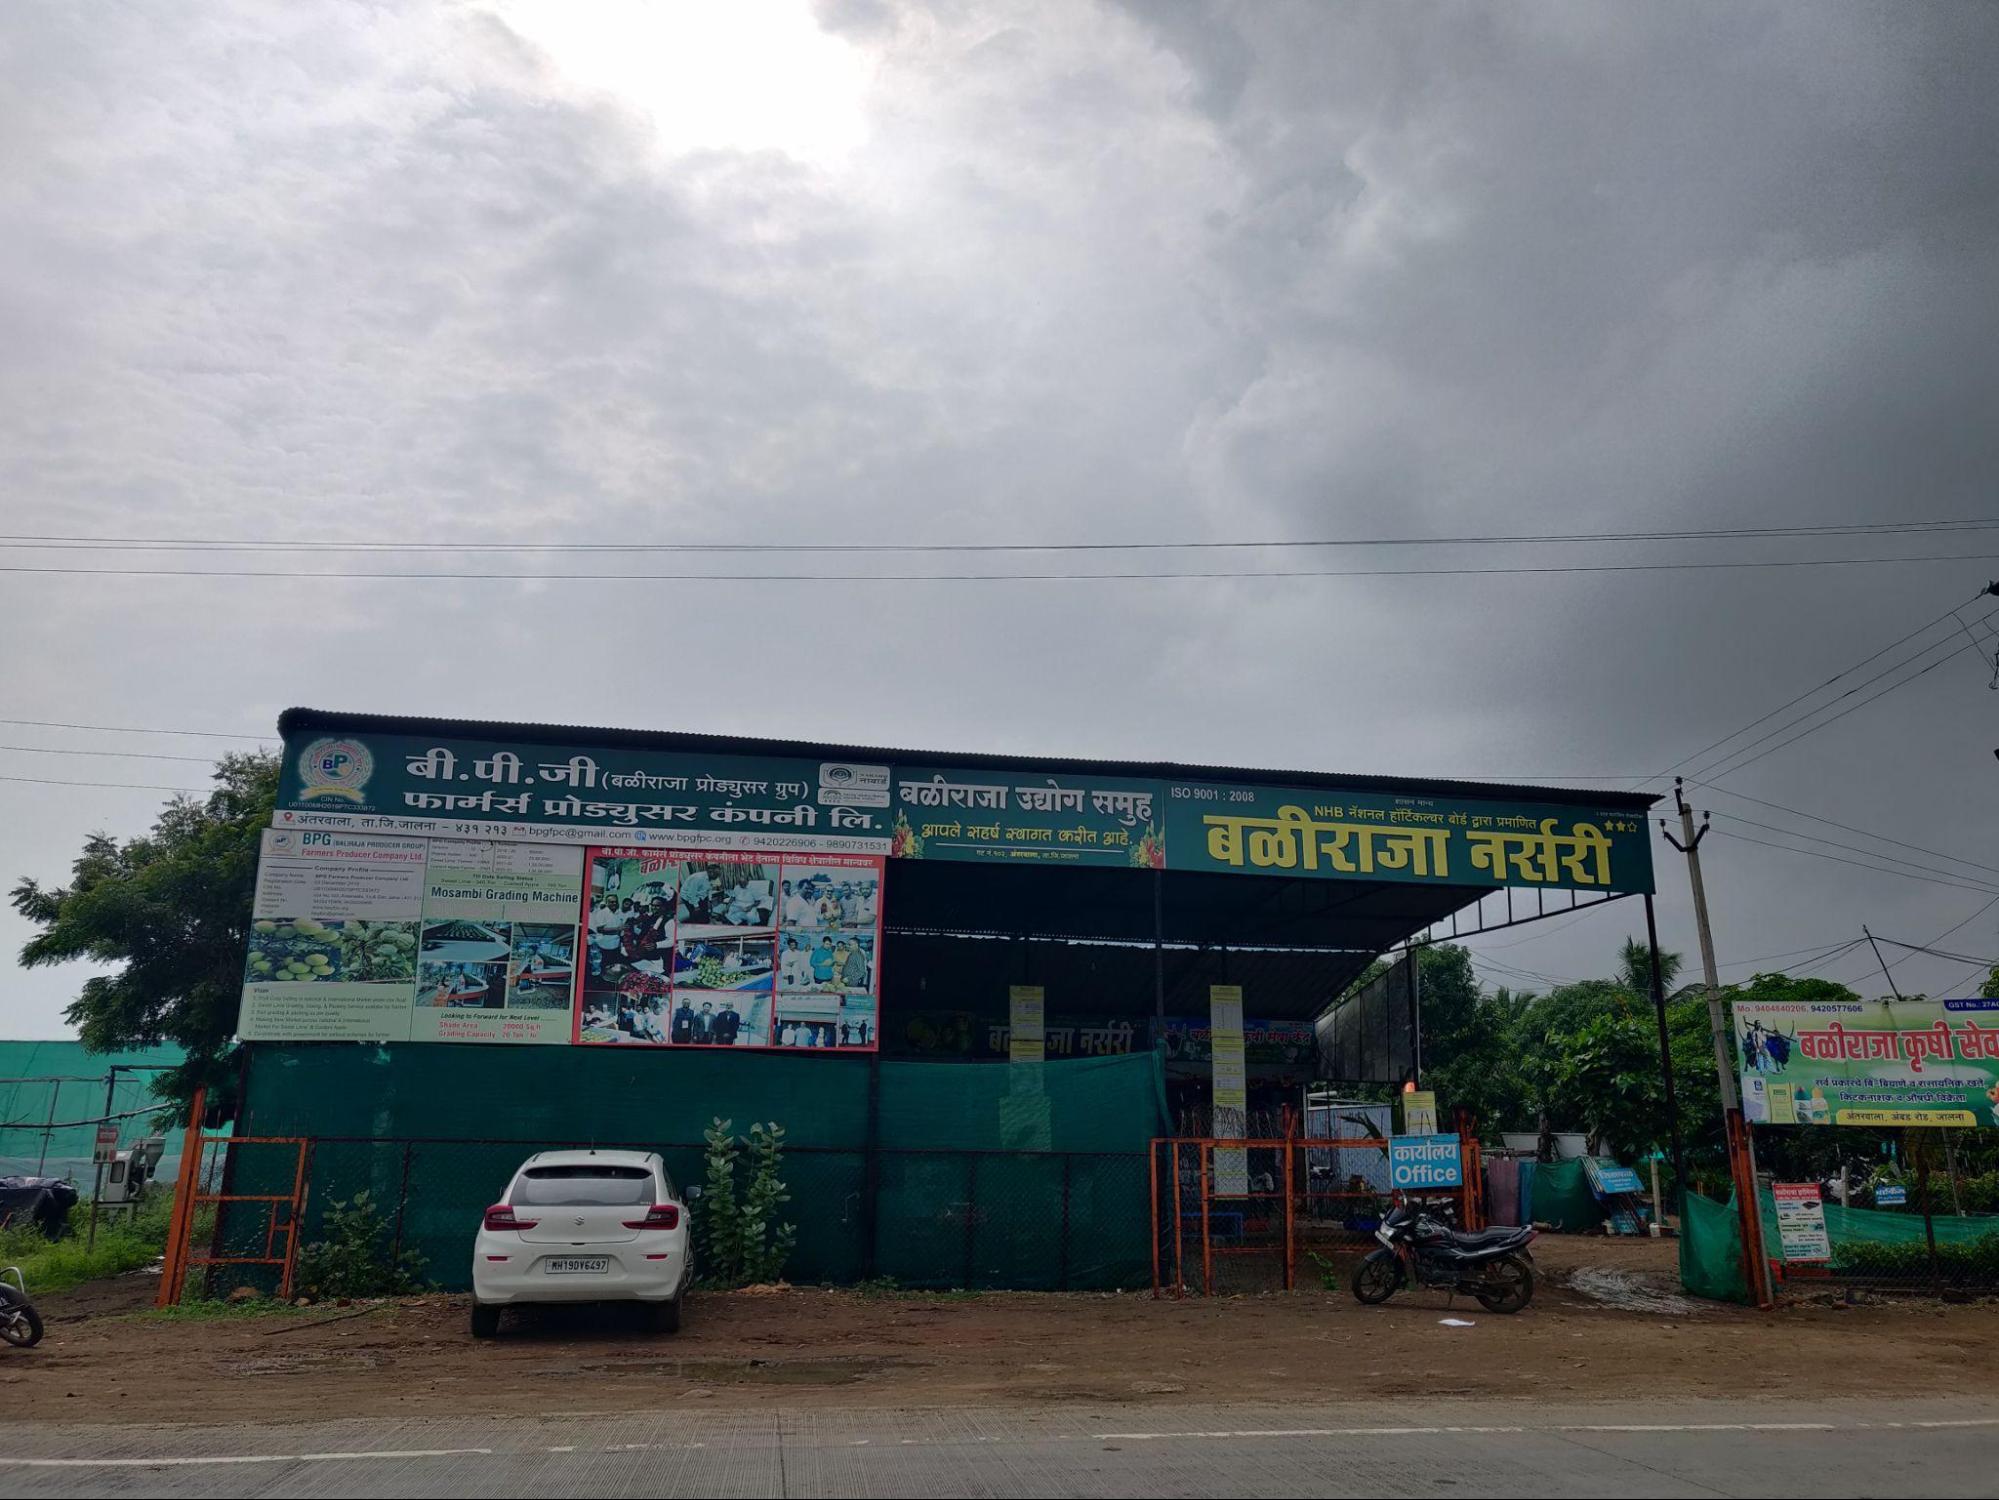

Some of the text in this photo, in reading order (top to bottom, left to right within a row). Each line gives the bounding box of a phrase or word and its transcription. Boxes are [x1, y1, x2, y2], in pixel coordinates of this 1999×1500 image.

[406, 747, 809, 799] बी.पी.जी (बळीराजा प्रोड्युसर ग्रुप)
[898, 774, 1153, 826] बळीराजा उद्योग समुह
[1170, 786, 1191, 800] ISO
[1194, 787, 1219, 801] 9001
[1229, 788, 1255, 803] 2008
[403, 790, 883, 830] फार्मर्स प्रोड्युसर कंपनी लि.
[1314, 805, 1344, 818] NHB
[302, 832, 332, 846] BPG
[529, 827, 632, 842] bpgfpc@gmail.com
[921, 821, 961, 839] आपले
[967, 822, 1000, 841] सहर्ष
[1005, 828, 1053, 842] स्वागत
[1059, 826, 1097, 845] करीत
[301, 848, 334, 857] Farmers
[336, 849, 372, 859] Producer
[373, 851, 408, 861] Company
[1202, 804, 1613, 886] बळीराजा नर्सरी
[431, 886, 579, 903] Mosambi Grading Machine
[1797, 1020, 1898, 1060] बळीराजा
[1901, 1020, 1954, 1073] कृषी
[1393, 1139, 1457, 1162] कार्यालय
[1394, 1165, 1457, 1184] Office
